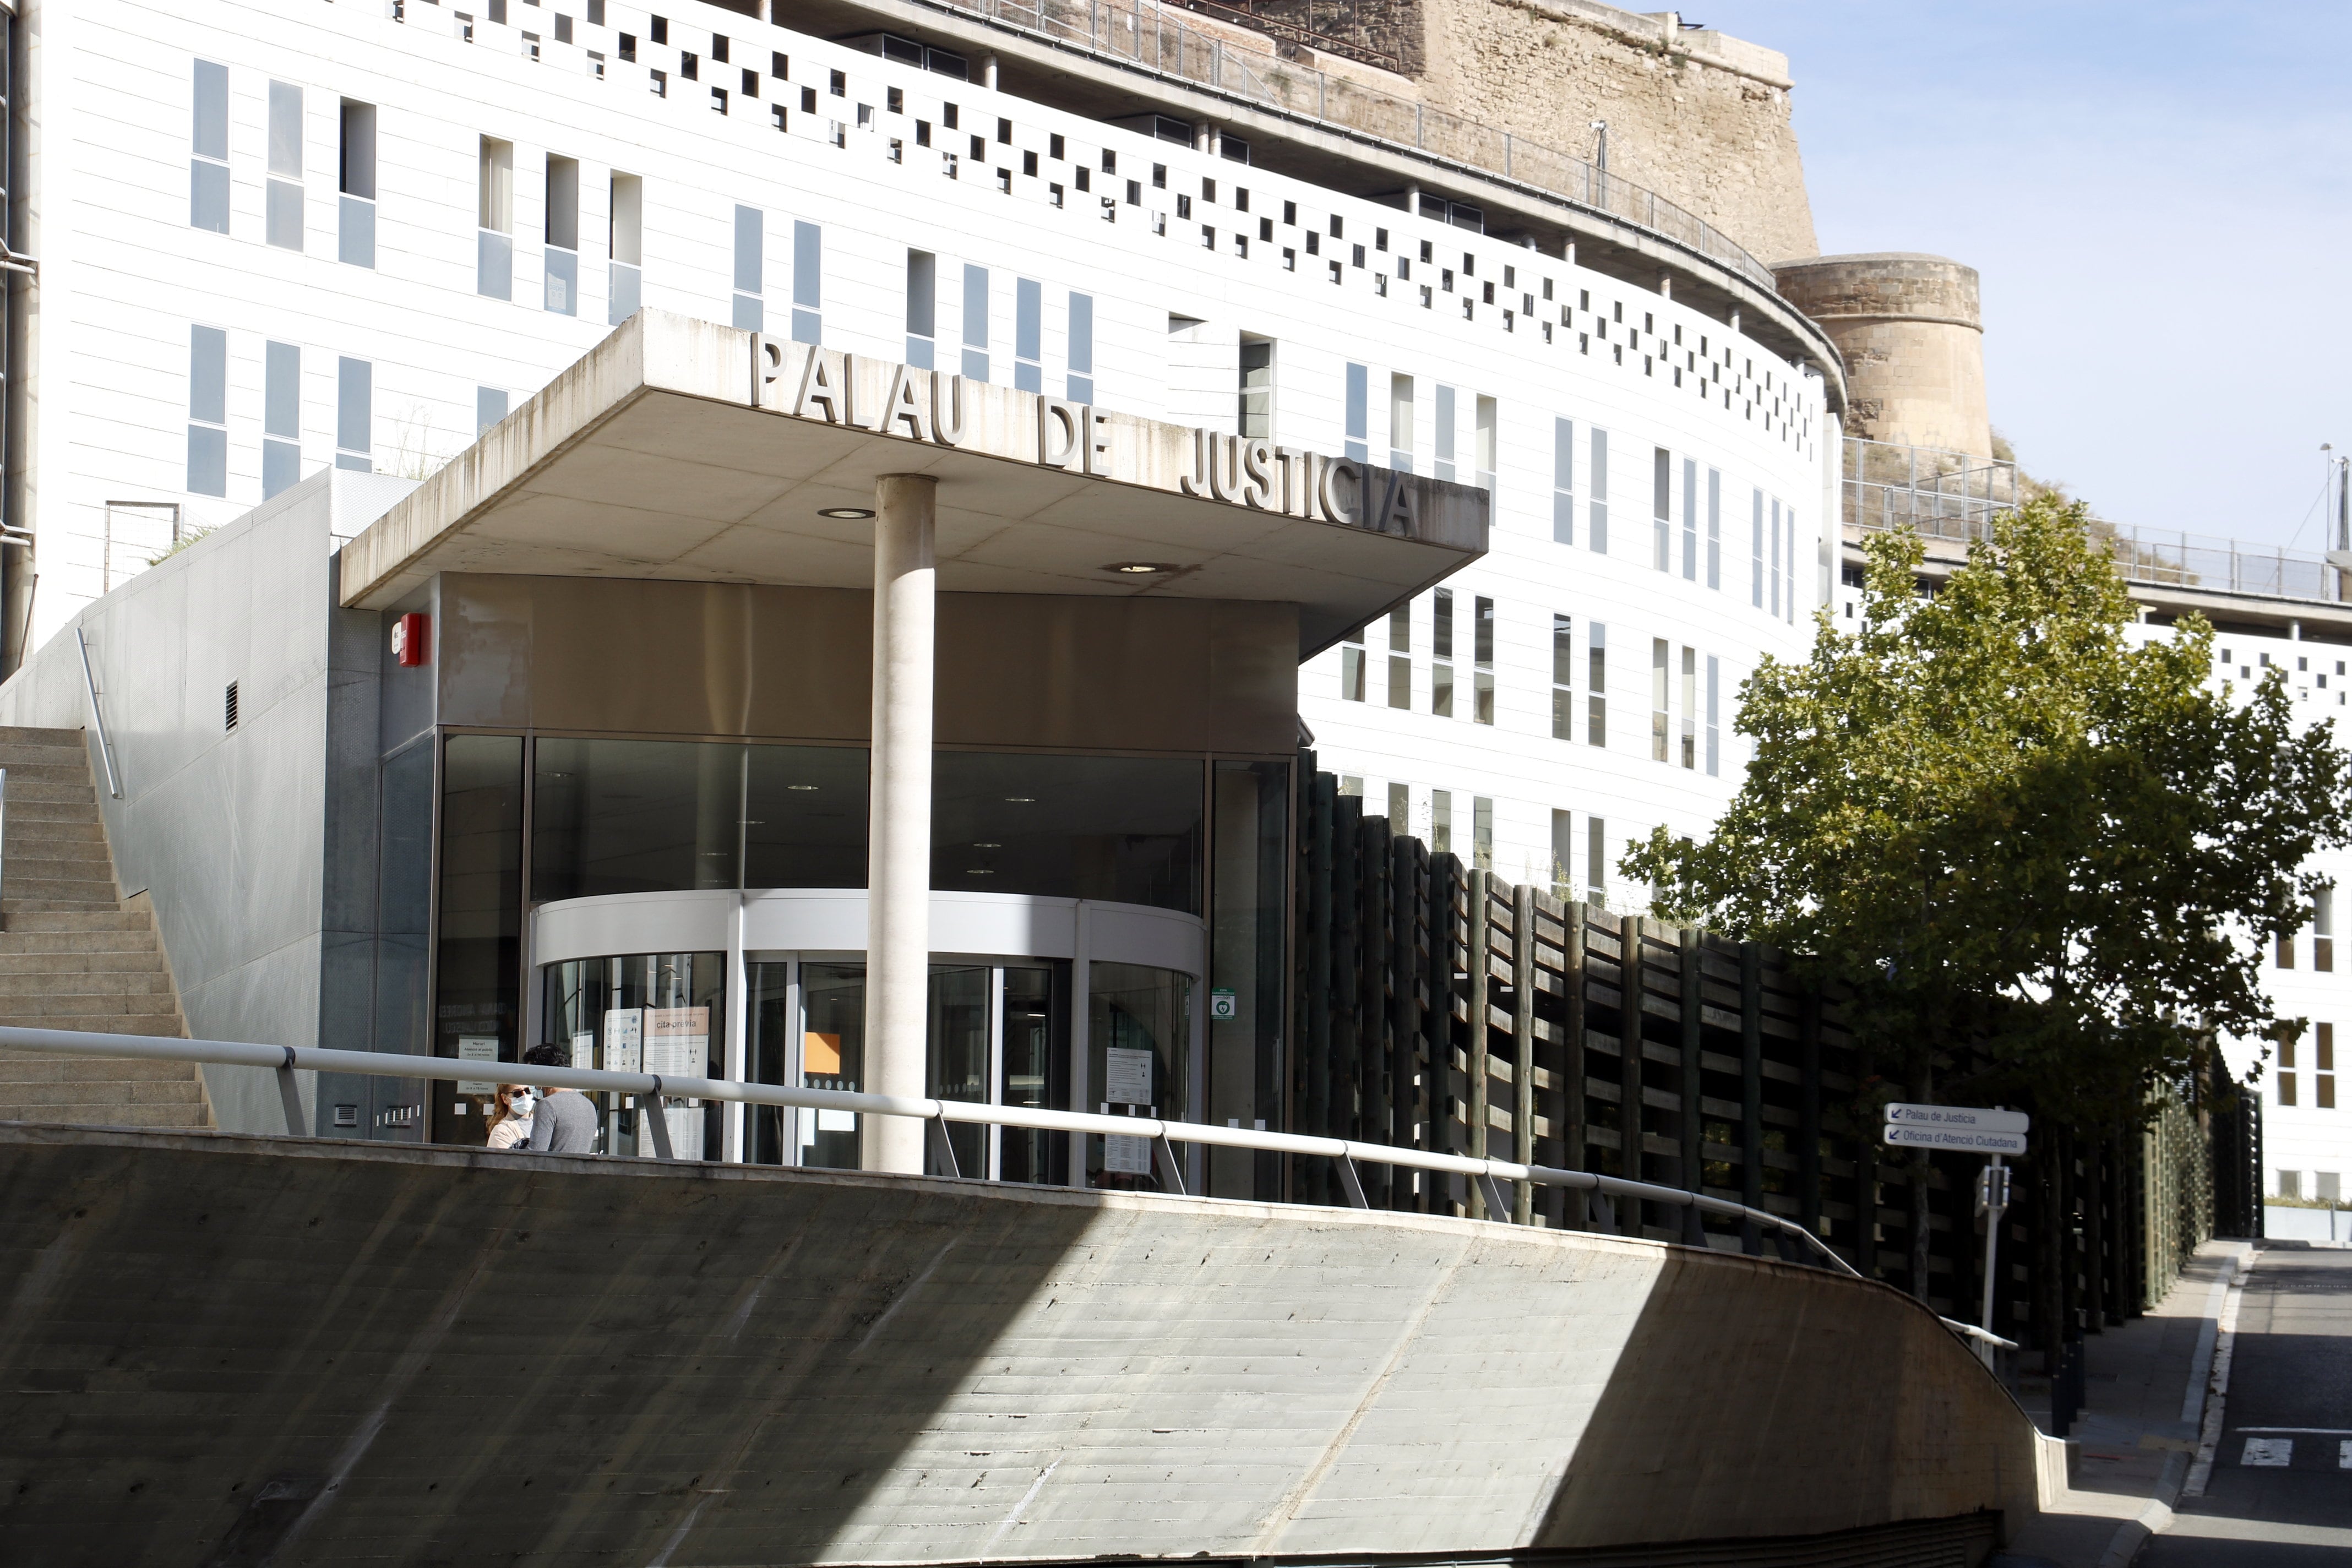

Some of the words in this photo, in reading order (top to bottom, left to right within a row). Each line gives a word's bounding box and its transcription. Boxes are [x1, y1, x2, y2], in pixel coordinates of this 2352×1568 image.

[750, 331, 966, 447] PALAU
[1038, 395, 1112, 477] DE
[1180, 427, 1418, 540] JUSTICIA
[672, 1020, 696, 1029] prèvia
[1905, 1109, 1928, 1120] Palau
[1931, 1111, 1941, 1121] de
[1903, 1130, 1931, 1142] Oficina
[1976, 1135, 2018, 1148] Ciutadana
